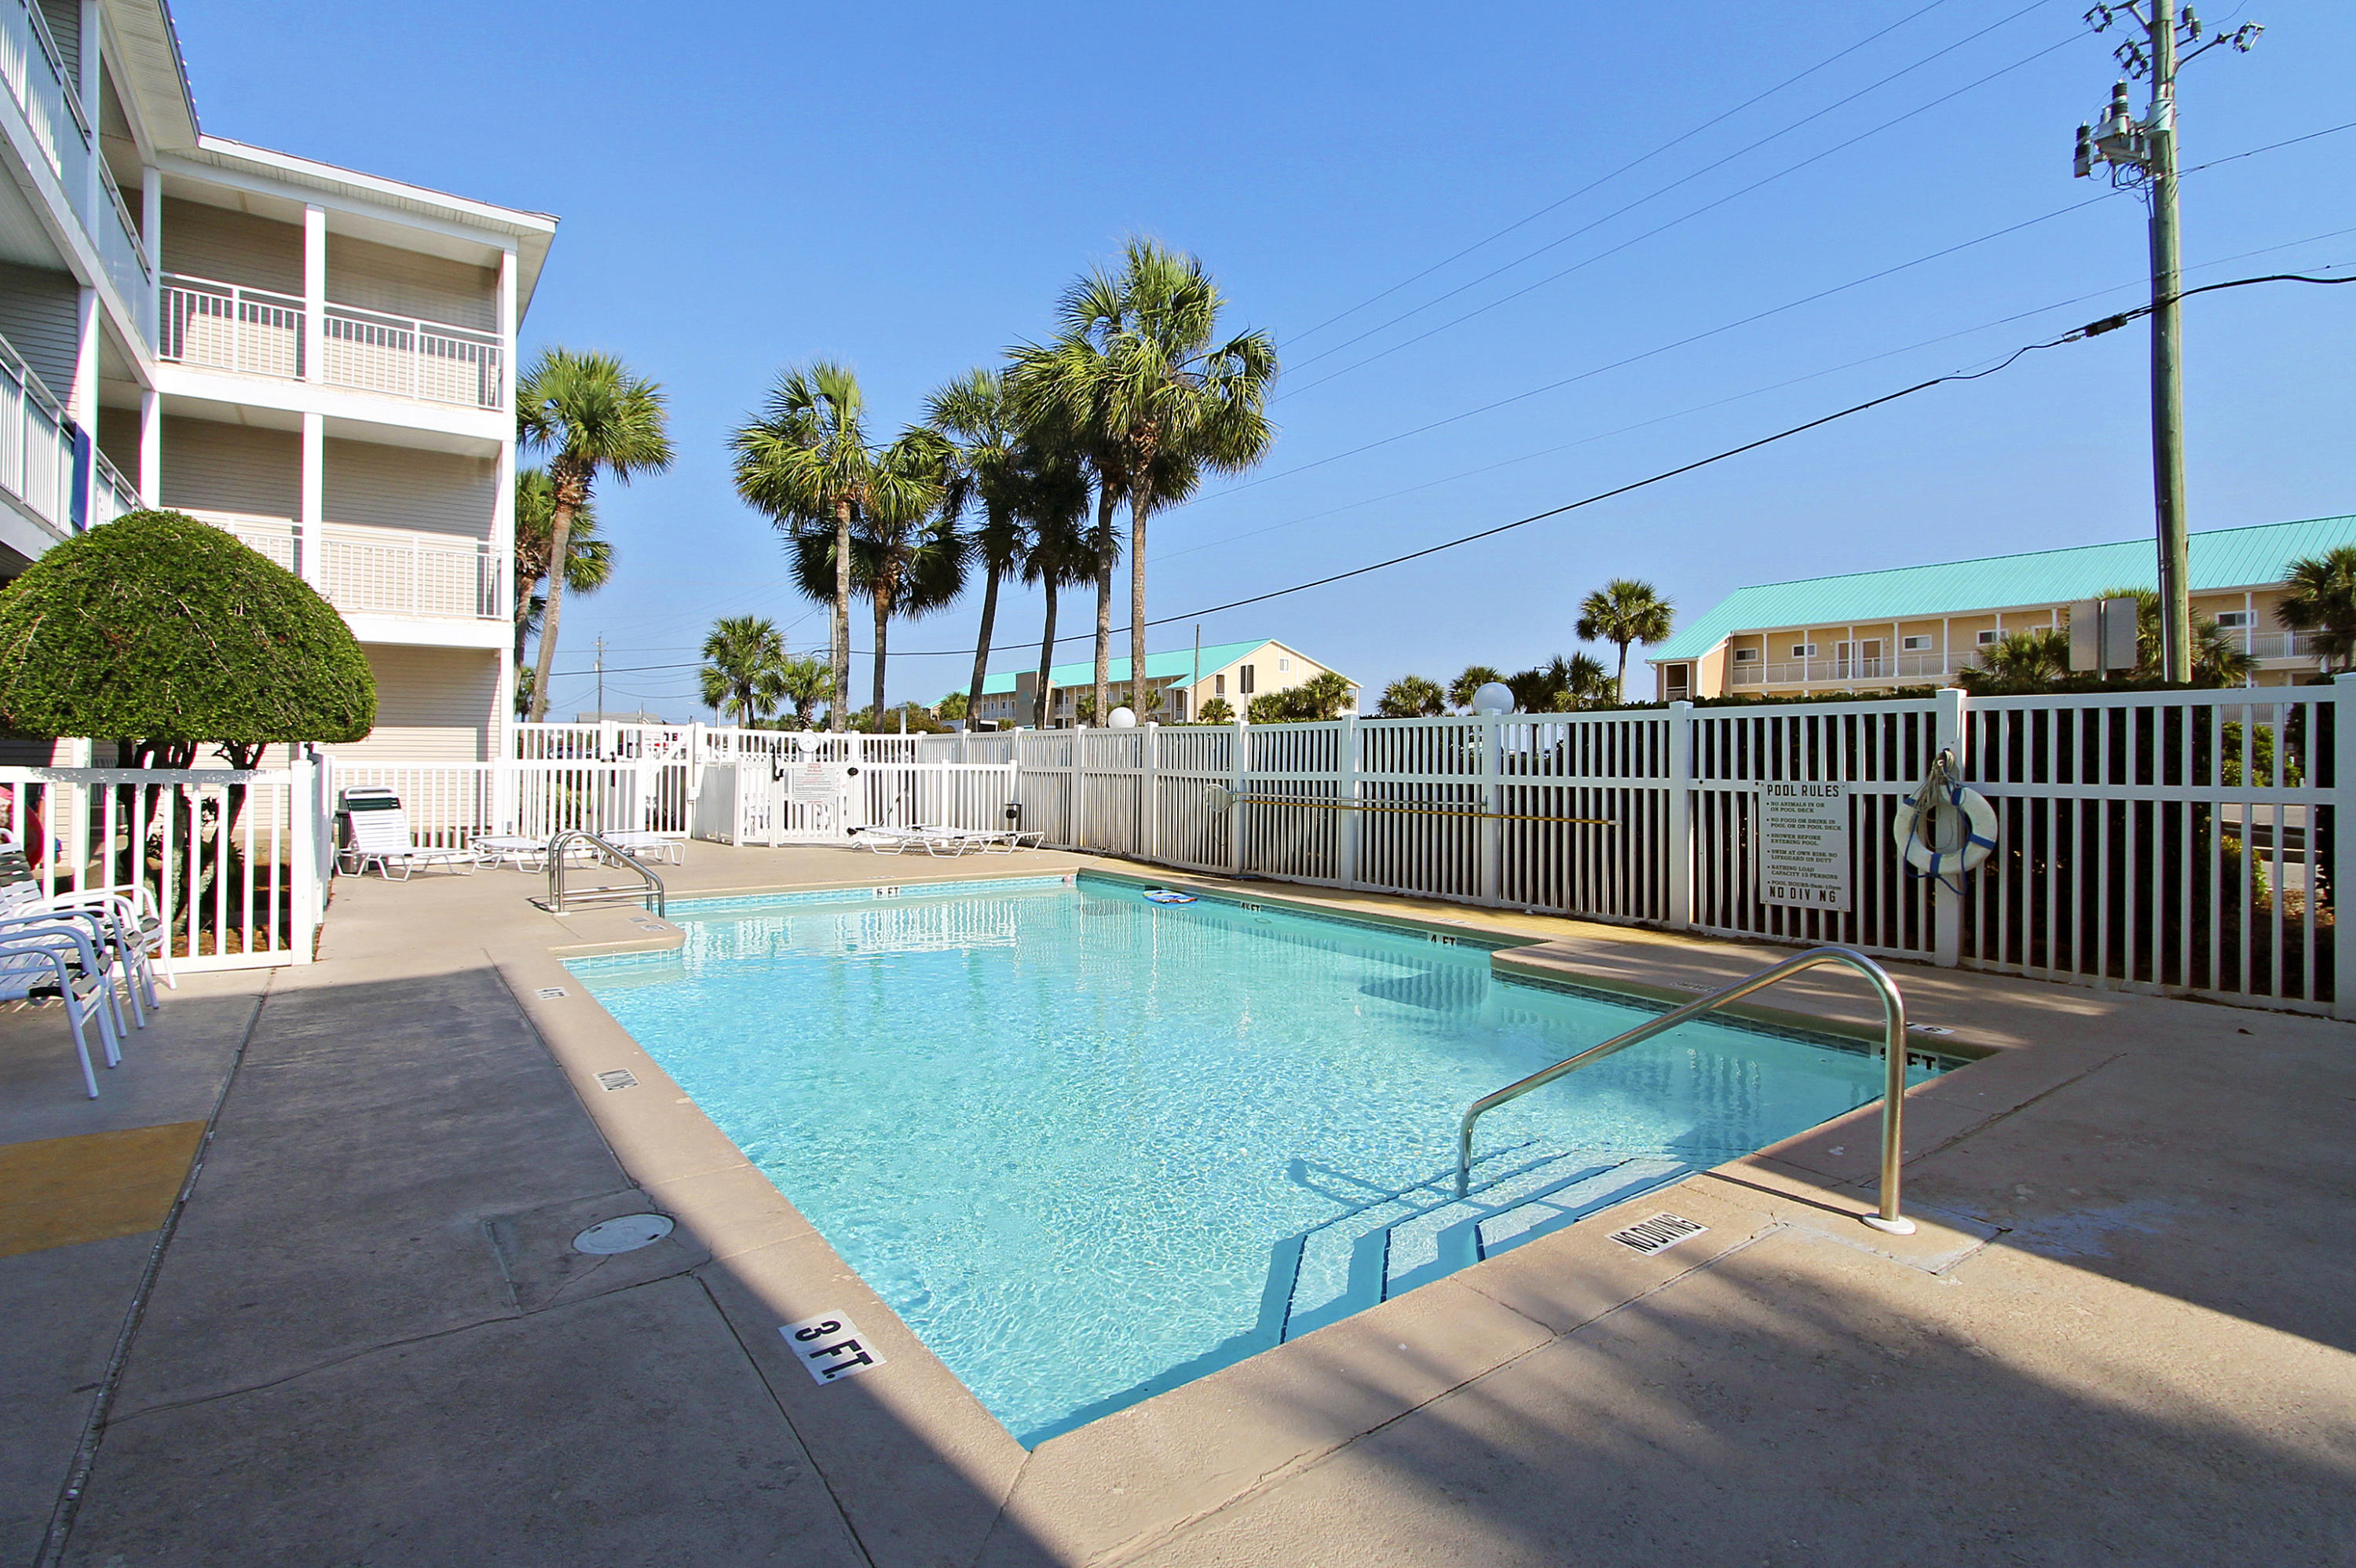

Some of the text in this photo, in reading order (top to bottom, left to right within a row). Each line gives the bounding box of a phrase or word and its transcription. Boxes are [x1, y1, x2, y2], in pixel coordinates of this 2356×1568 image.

[1767, 784, 1839, 797] POOL RULES
[1769, 886, 1784, 898] NO
[1611, 1214, 1703, 1253] NO DIVING
[795, 1321, 841, 1341] 3
